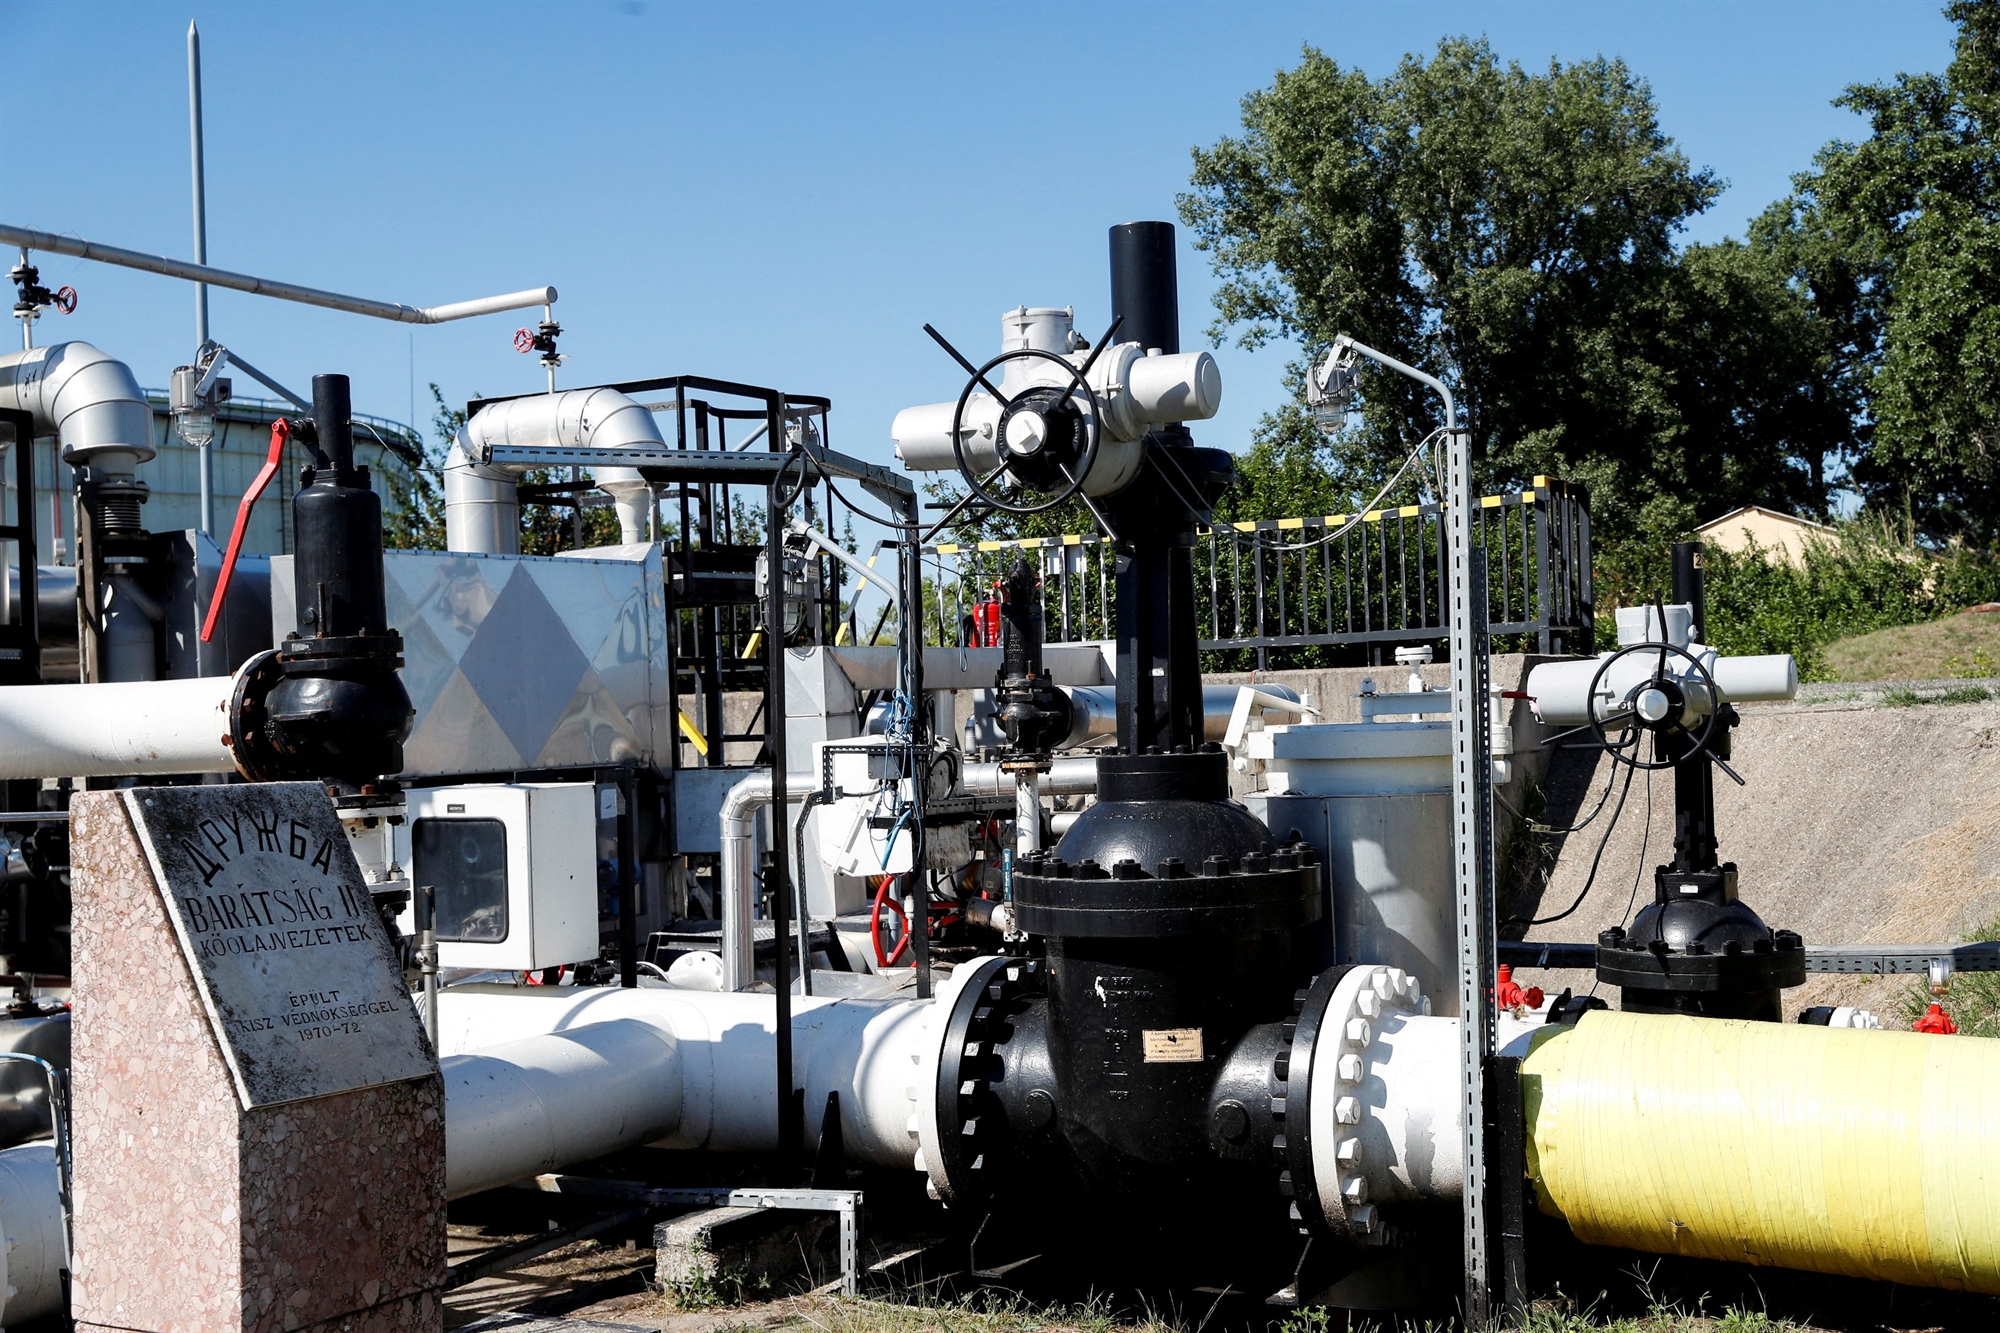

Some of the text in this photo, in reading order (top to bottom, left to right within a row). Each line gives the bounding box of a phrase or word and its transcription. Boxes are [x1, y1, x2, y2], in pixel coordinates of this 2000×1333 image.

[1695, 553, 1702, 567] 2
[181, 810, 333, 888] ДРУЖБА
[184, 879, 361, 933] BARÁTSÁG II
[288, 989, 340, 1008] ÉPÜLT
[298, 1022, 361, 1042] 1970-72
